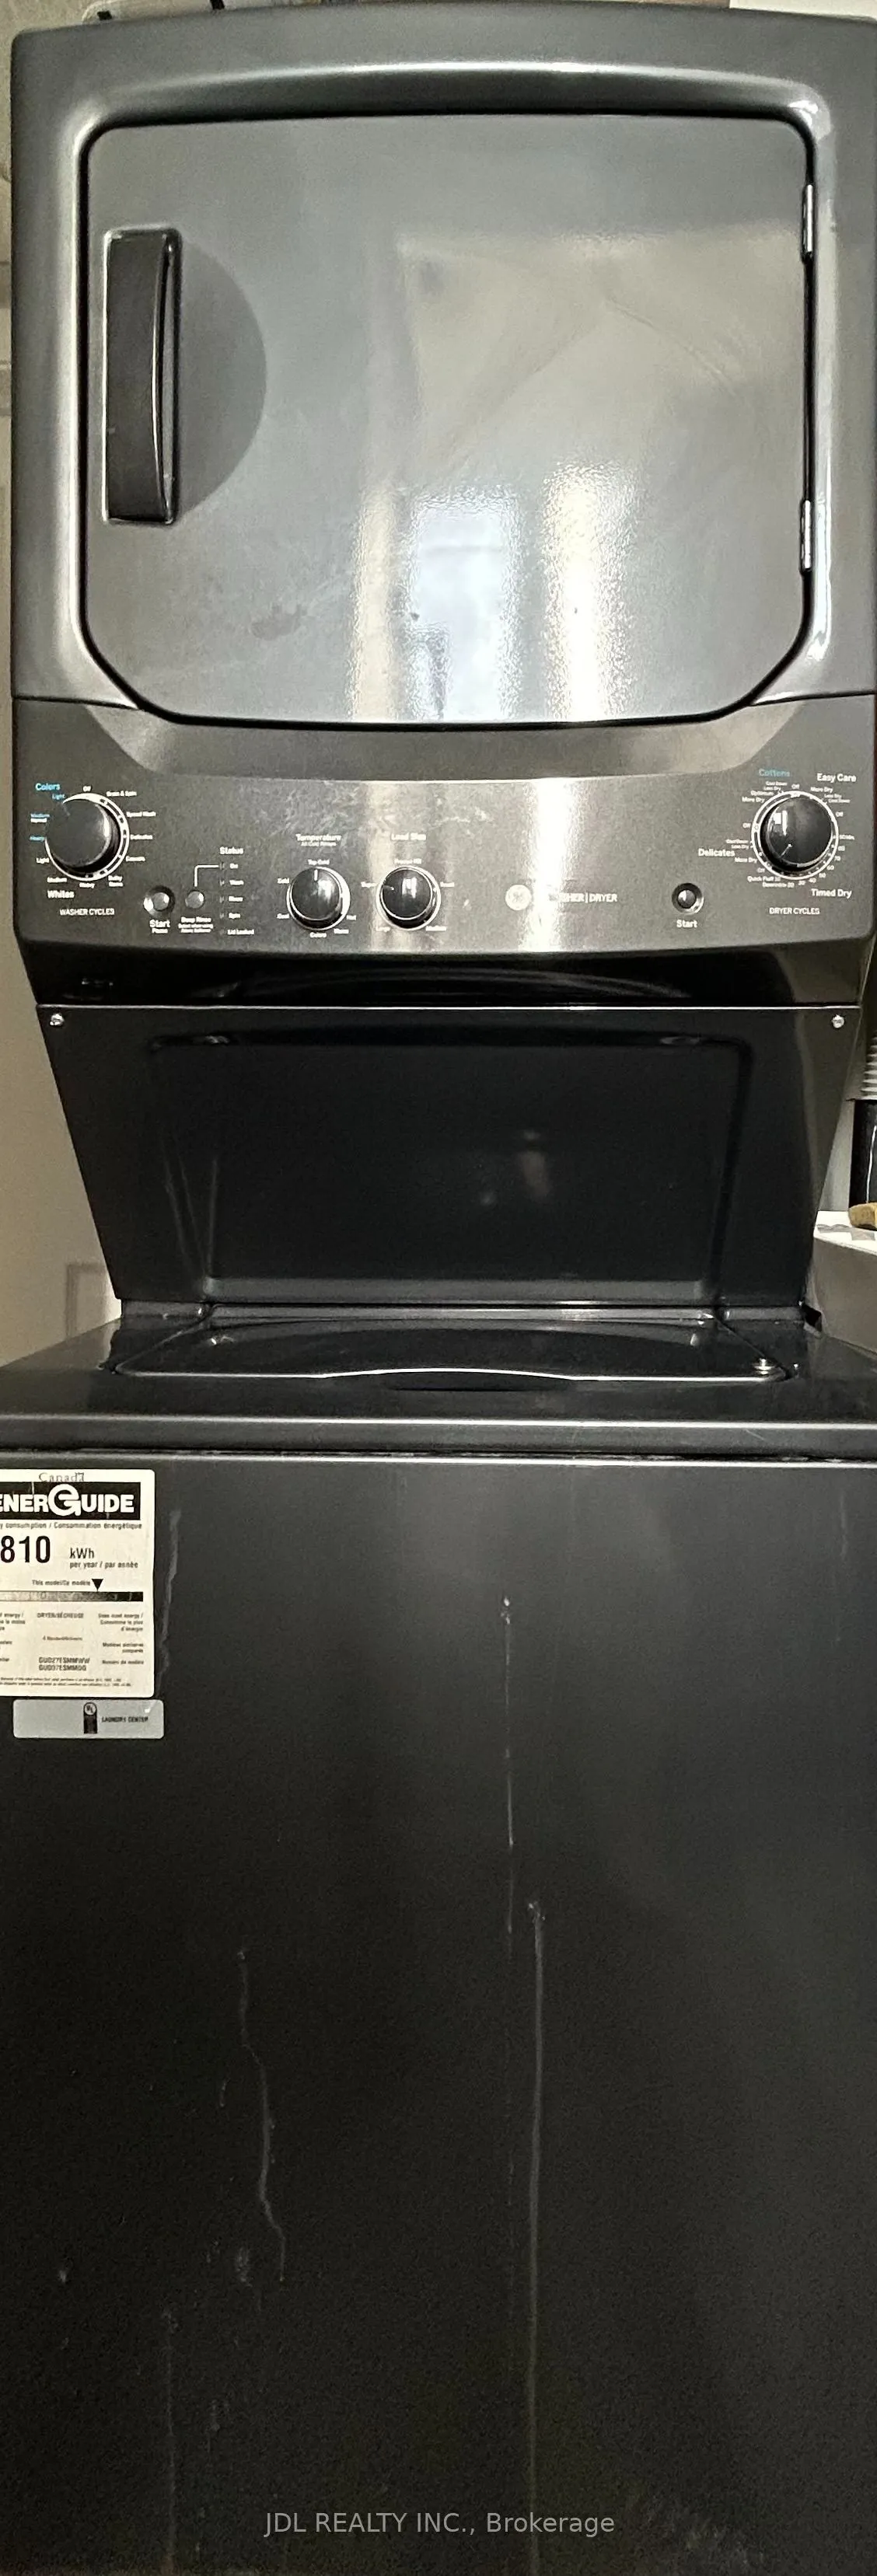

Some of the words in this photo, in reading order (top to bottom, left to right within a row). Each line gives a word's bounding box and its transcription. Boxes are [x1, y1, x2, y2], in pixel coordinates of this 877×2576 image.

[817, 773, 836, 784] Easy
[837, 773, 857, 782] Care
[35, 783, 61, 791] Colors
[295, 833, 341, 842] Temperature
[219, 846, 243, 855] Status
[698, 848, 735, 857] Delicates
[47, 890, 75, 899] Whites
[837, 889, 852, 899] Dry
[149, 919, 171, 928] Start
[676, 920, 697, 928] Start
[0, 1535, 51, 1563] 810
[69, 1547, 95, 1559] kWh
